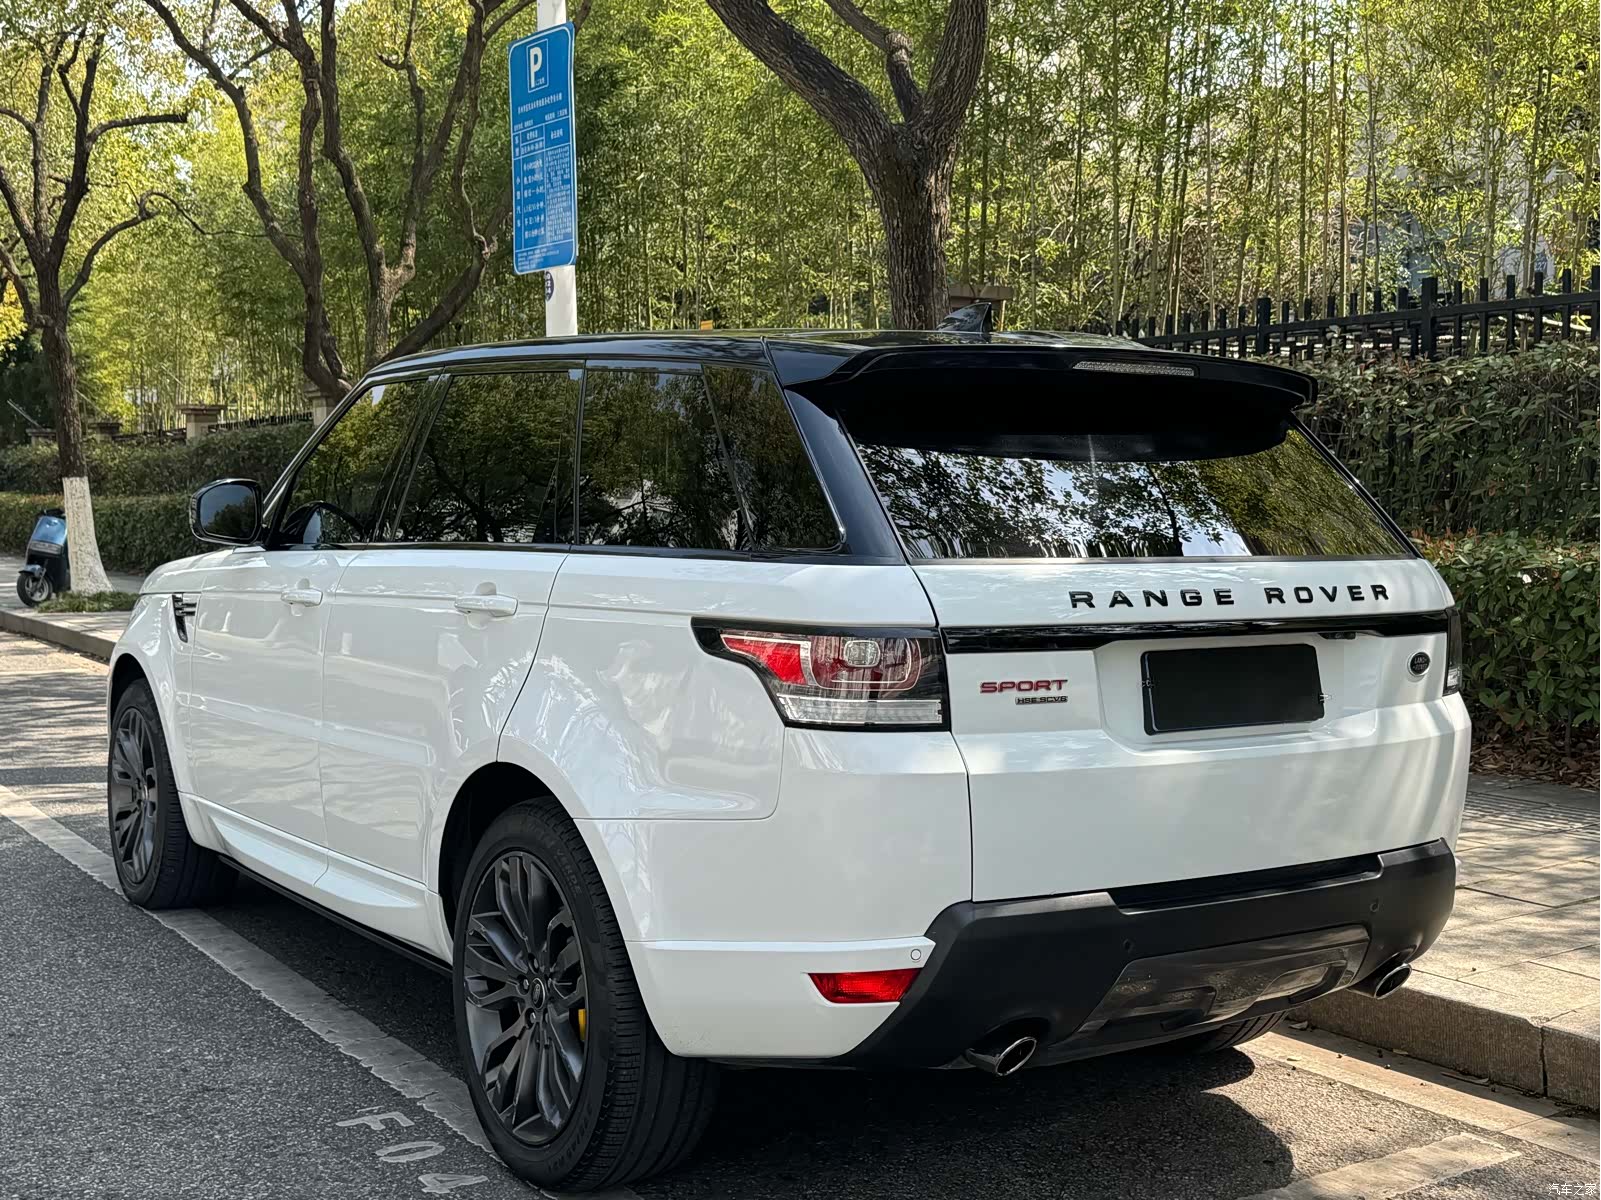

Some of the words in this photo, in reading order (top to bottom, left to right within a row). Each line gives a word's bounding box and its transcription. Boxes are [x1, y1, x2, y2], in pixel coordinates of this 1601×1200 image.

[529, 46, 543, 89] P
[1068, 588, 1235, 609] RANGE
[1263, 584, 1390, 604] ROVER
[979, 679, 1069, 694] SPORT
[1017, 697, 1038, 705] HSE
